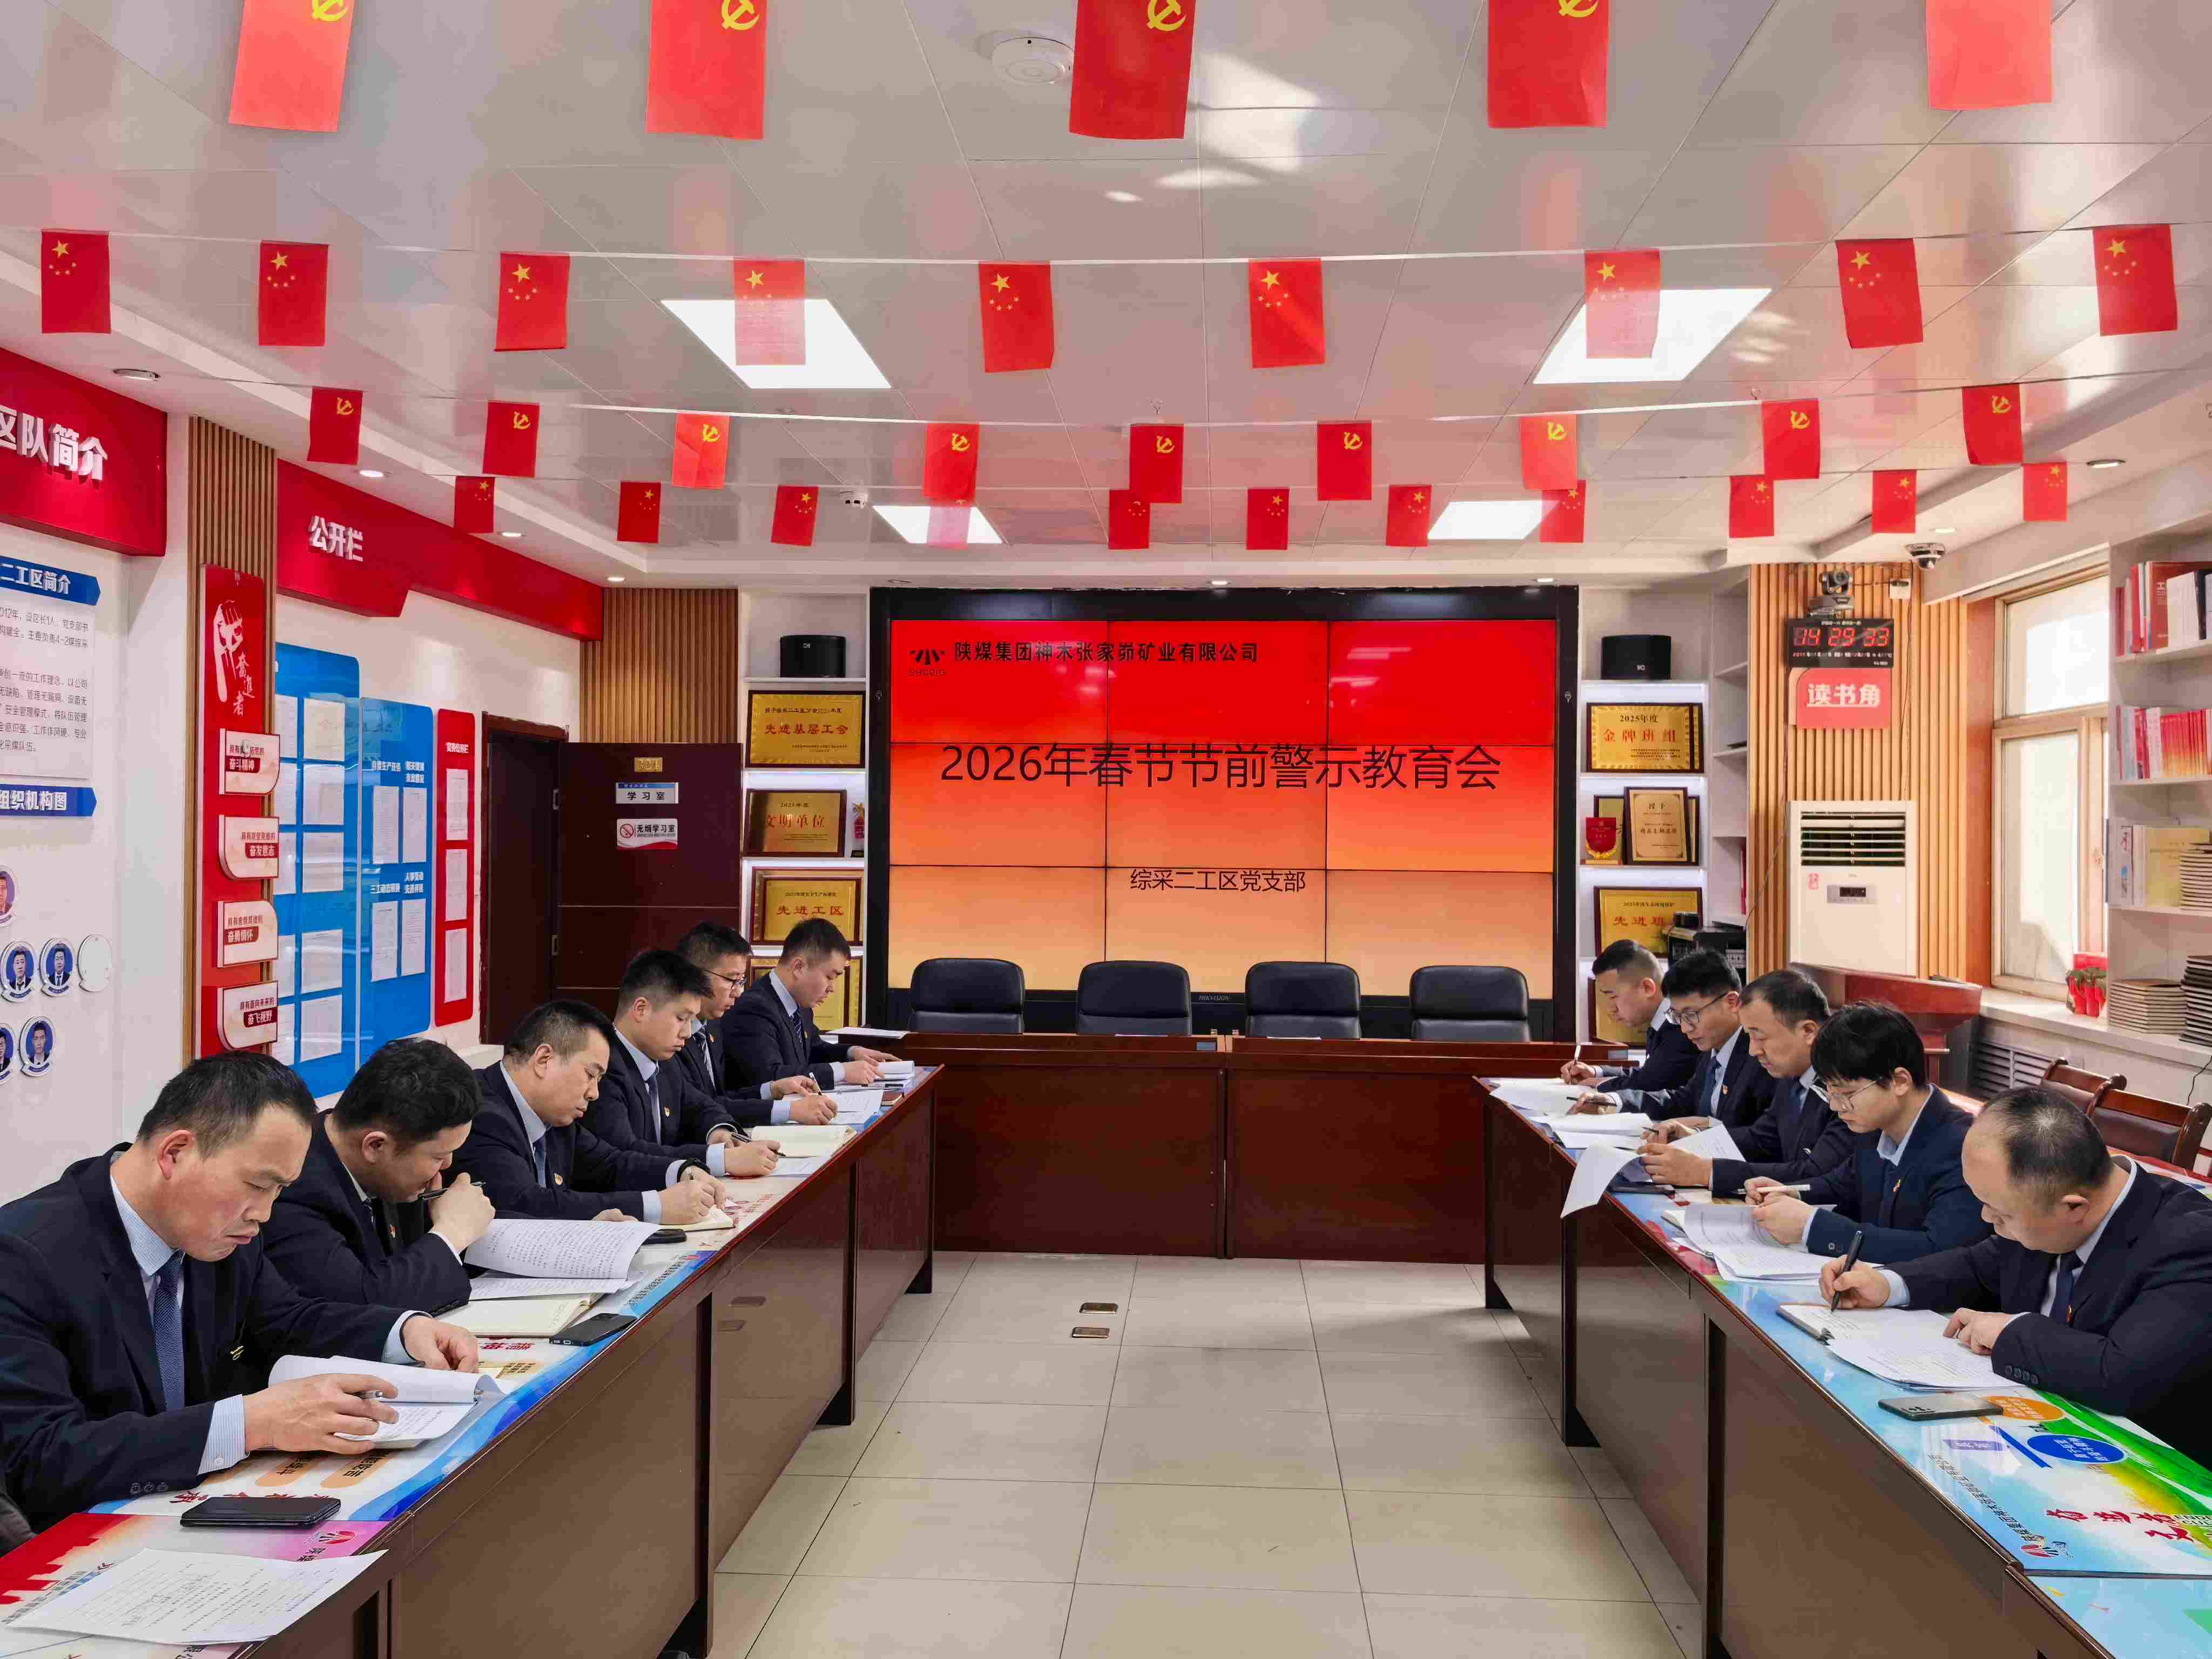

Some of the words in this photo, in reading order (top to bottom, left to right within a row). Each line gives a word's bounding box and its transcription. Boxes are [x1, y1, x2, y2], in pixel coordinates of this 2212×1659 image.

[312, 515, 363, 562] 公开栏
[0, 563, 71, 594] 二工区简介
[1800, 628, 1821, 647] 14
[1827, 628, 1856, 647] 29
[954, 641, 1258, 662] 陕煤集团神木张家峁矿业有限公司
[1806, 683, 1881, 707] 读书角
[1620, 714, 1658, 723] 2025年度
[765, 723, 848, 735] 先进基层工会
[1603, 729, 1676, 743] 金牌班组
[941, 743, 1501, 790] 2026年春节节前警示教育会
[0, 790, 67, 811] 组织机构图
[628, 791, 665, 800] 学习室
[637, 825, 675, 833] 无烟学习室
[765, 812, 825, 830] 文明单位
[1131, 869, 1306, 894] 综采二工区党支部
[776, 906, 844, 916] 先进工区
[1613, 915, 1664, 927] 先进班
